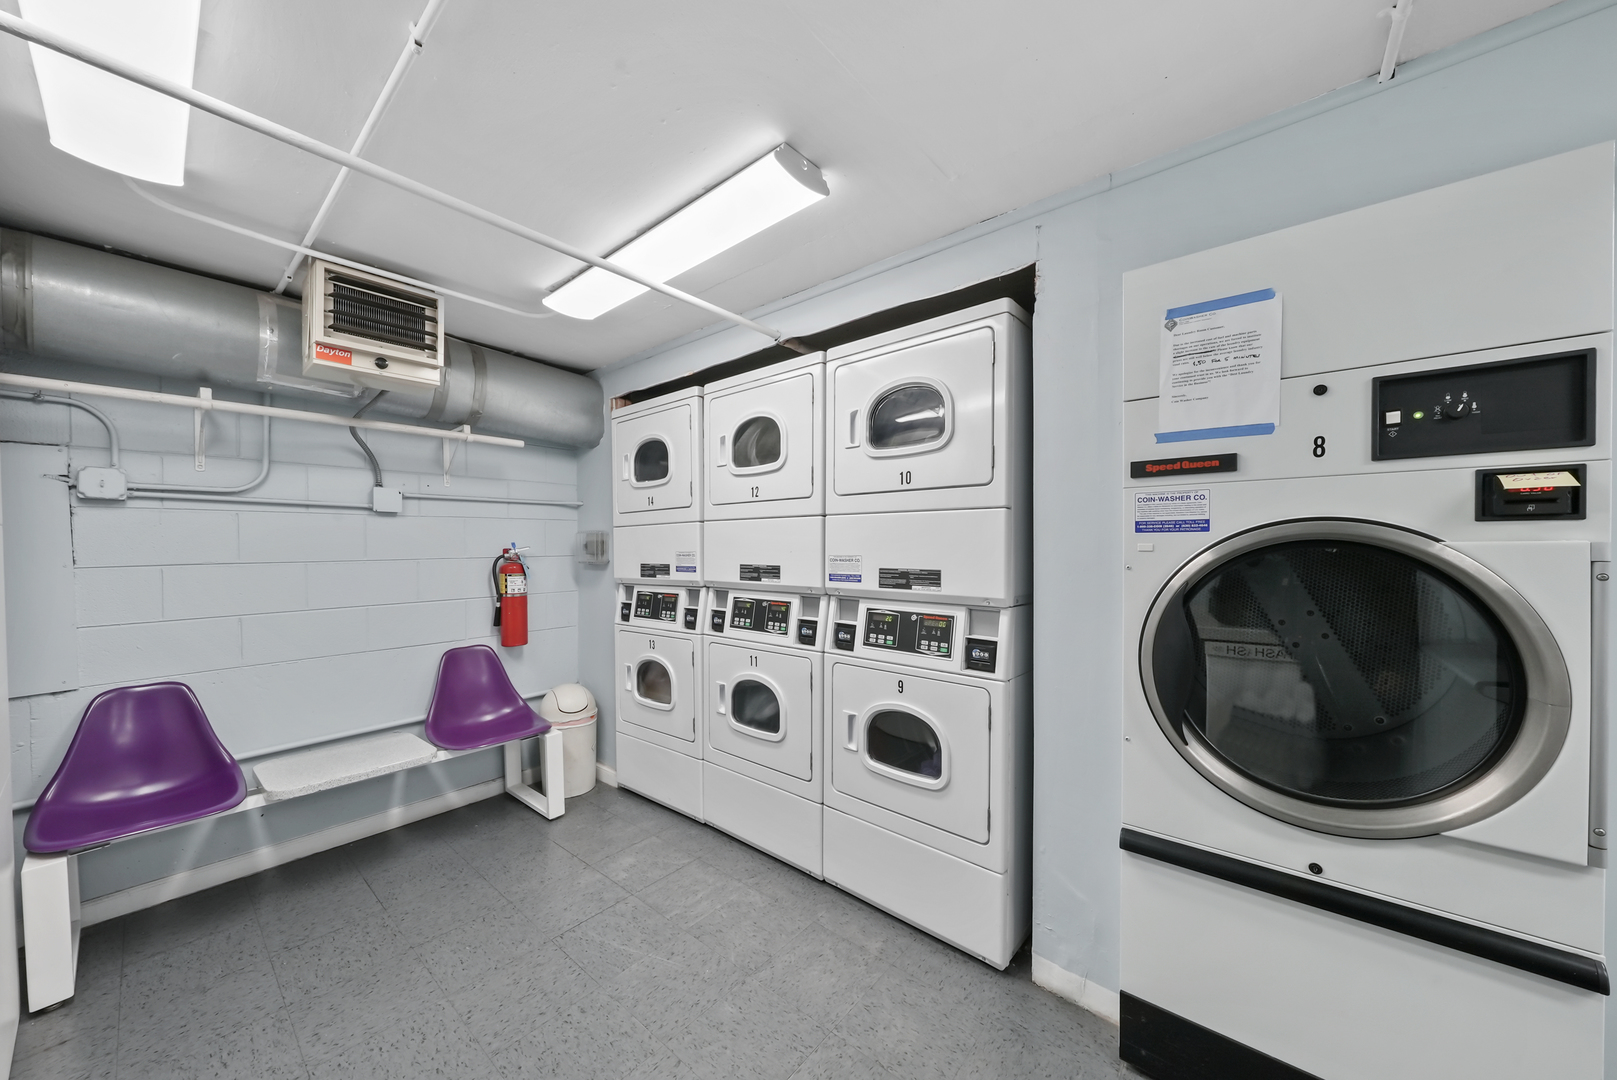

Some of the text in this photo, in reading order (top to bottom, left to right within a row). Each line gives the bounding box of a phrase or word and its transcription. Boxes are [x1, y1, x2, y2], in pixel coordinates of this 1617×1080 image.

[316, 345, 350, 358] Dayton
[1312, 436, 1326, 458] 8
[1146, 460, 1219, 473] Speed Queen
[899, 471, 912, 486] 10
[751, 486, 759, 498] 12
[647, 497, 654, 506] 14
[1137, 495, 1191, 503] COIN-WASHER
[649, 640, 655, 650] 13
[750, 655, 758, 667] 11
[898, 680, 904, 693] 9
